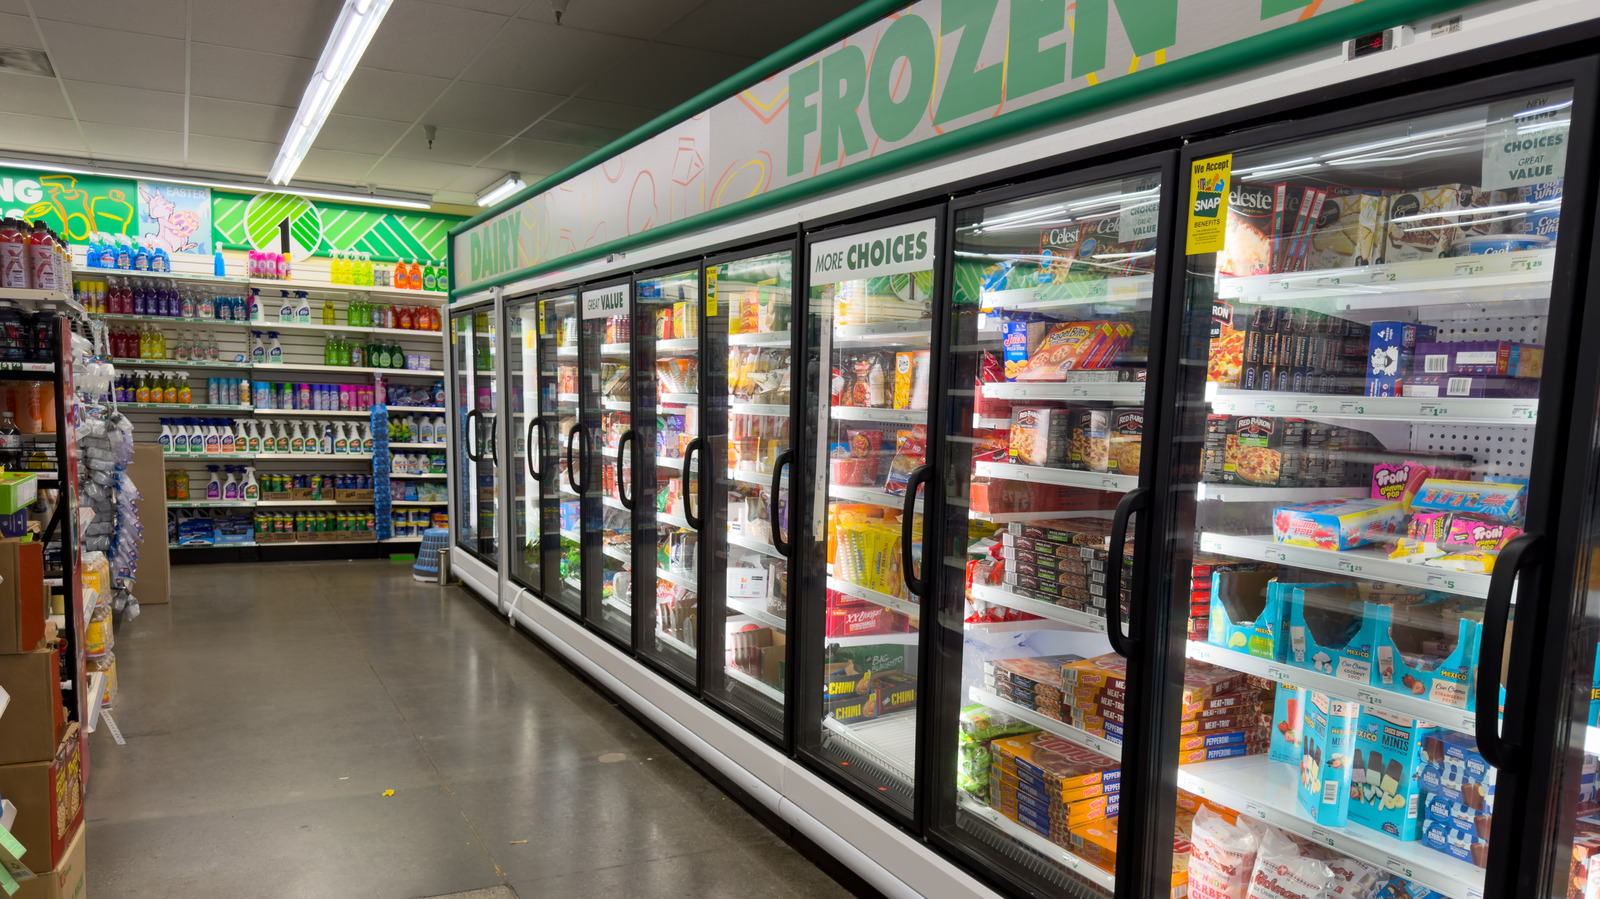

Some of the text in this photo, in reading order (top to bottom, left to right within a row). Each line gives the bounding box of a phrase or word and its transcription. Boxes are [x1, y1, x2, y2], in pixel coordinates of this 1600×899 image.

[787, 0, 1178, 178] FROZEN
[1526, 97, 1548, 108] NEW
[1504, 133, 1563, 154] CHOICES
[1518, 155, 1544, 166] GREAT
[1194, 159, 1229, 174] We Accept
[1509, 165, 1553, 181] VALUE
[166, 186, 207, 200] EASTER
[1130, 203, 1160, 216] CHOICES
[1195, 197, 1221, 212] SNAP
[1194, 219, 1220, 228] BENEFITS
[1133, 225, 1156, 236] VALUE
[471, 210, 521, 281] DAIRY
[815, 231, 928, 273] MORE CHOICES
[1386, 273, 1396, 281] $2
[601, 292, 623, 310] VALUE
[1048, 327, 1089, 342] Bagel Bites
[1309, 405, 1318, 413] $2
[1119, 415, 1130, 424] RED
[1238, 418, 1271, 429] RED BARON
[1376, 465, 1409, 487] Trolli
[1386, 490, 1400, 500] POP
[1292, 520, 1318, 529] BOMB
[1293, 527, 1313, 536] POP
[1473, 526, 1504, 540] Trolli
[1444, 580, 1454, 589] $5
[872, 654, 889, 666] BIG
[1343, 668, 1365, 677] COCONUT
[829, 681, 855, 695] CHIMI
[1435, 682, 1447, 690] Con
[891, 689, 914, 705] CHIMI
[1434, 691, 1466, 702] STRAWBERRY
[1442, 697, 1458, 705] FRESA
[836, 704, 861, 720] CHIMI
[1332, 704, 1342, 713] 12
[1384, 726, 1409, 739] CHOCO DIPPER
[1206, 735, 1229, 746] PEPPERONI
[1382, 735, 1410, 752] MINIS
[1208, 748, 1231, 759] PEPPERONI
[1424, 774, 1438, 786] RIBBON
[1431, 806, 1449, 817] RIBBON
[1428, 832, 1446, 843] RIBBON
[1402, 867, 1412, 877] $5
